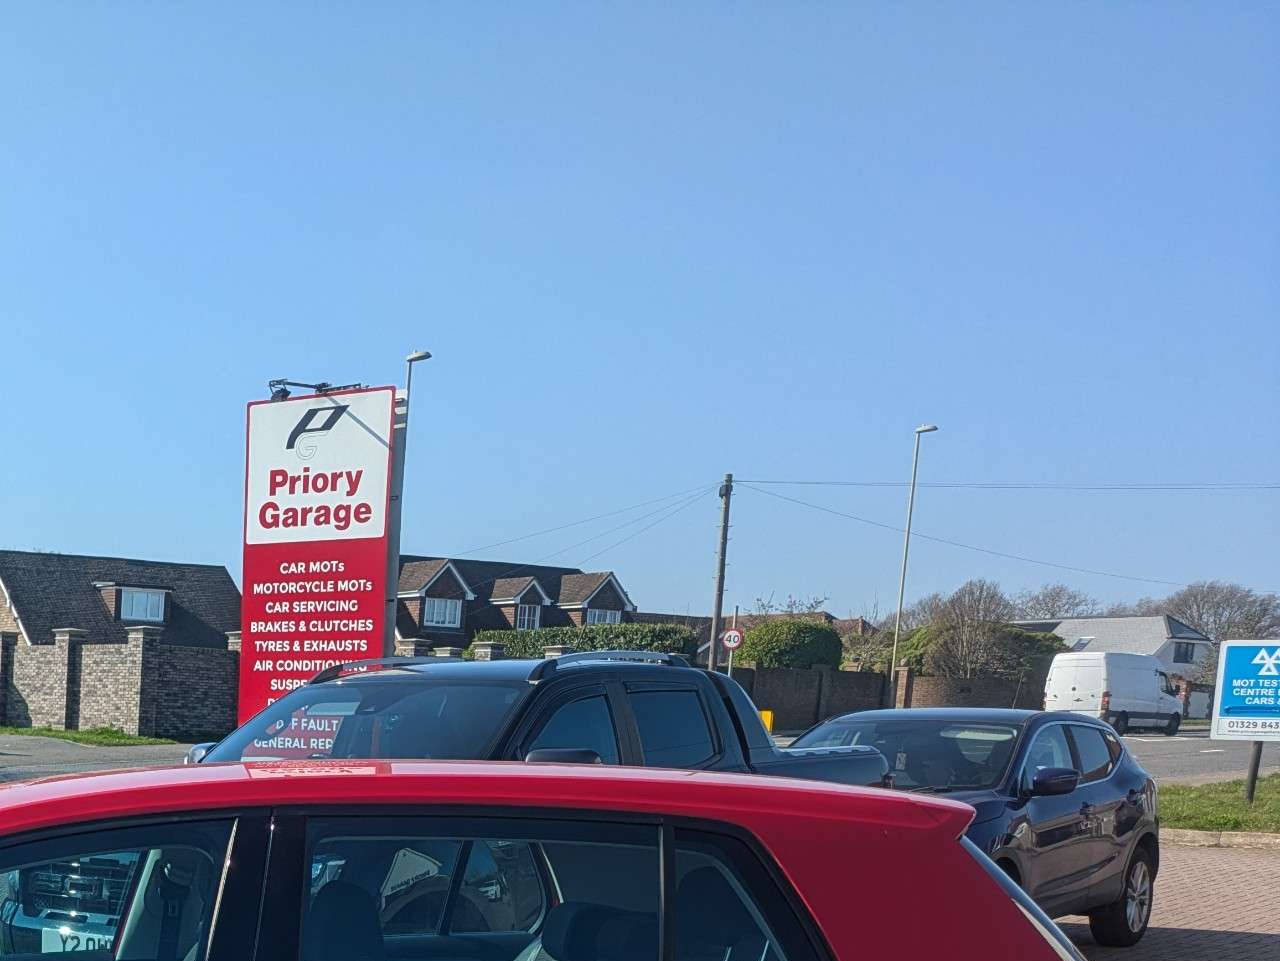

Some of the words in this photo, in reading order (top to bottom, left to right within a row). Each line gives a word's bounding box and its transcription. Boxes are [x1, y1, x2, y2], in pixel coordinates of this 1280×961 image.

[269, 466, 363, 497] Priory
[258, 501, 372, 531] Garage
[279, 562, 305, 574] CAR
[309, 560, 345, 573] MOTs
[253, 580, 335, 595] MOTORCYCLE
[337, 579, 373, 592] MOTs
[265, 602, 290, 614] CAR
[292, 600, 358, 613] SERVICING
[250, 621, 296, 633] BRAKES
[298, 621, 307, 632] &
[309, 619, 374, 632] CLUTCHES
[726, 634, 740, 644] 40
[254, 640, 290, 652] TYRES
[292, 641, 301, 651] &
[303, 640, 368, 652] EXHAUSTS
[253, 660, 273, 671] AIR
[276, 660, 367, 672] CONDITIO
[1232, 679, 1256, 687] MOT
[1258, 679, 1280, 687] TES
[1232, 688, 1275, 696] CENTRE
[1245, 697, 1274, 705] CARS
[1227, 720, 1258, 729] 01329
[254, 737, 307, 749] GENERAL
[310, 738, 334, 750] REP
